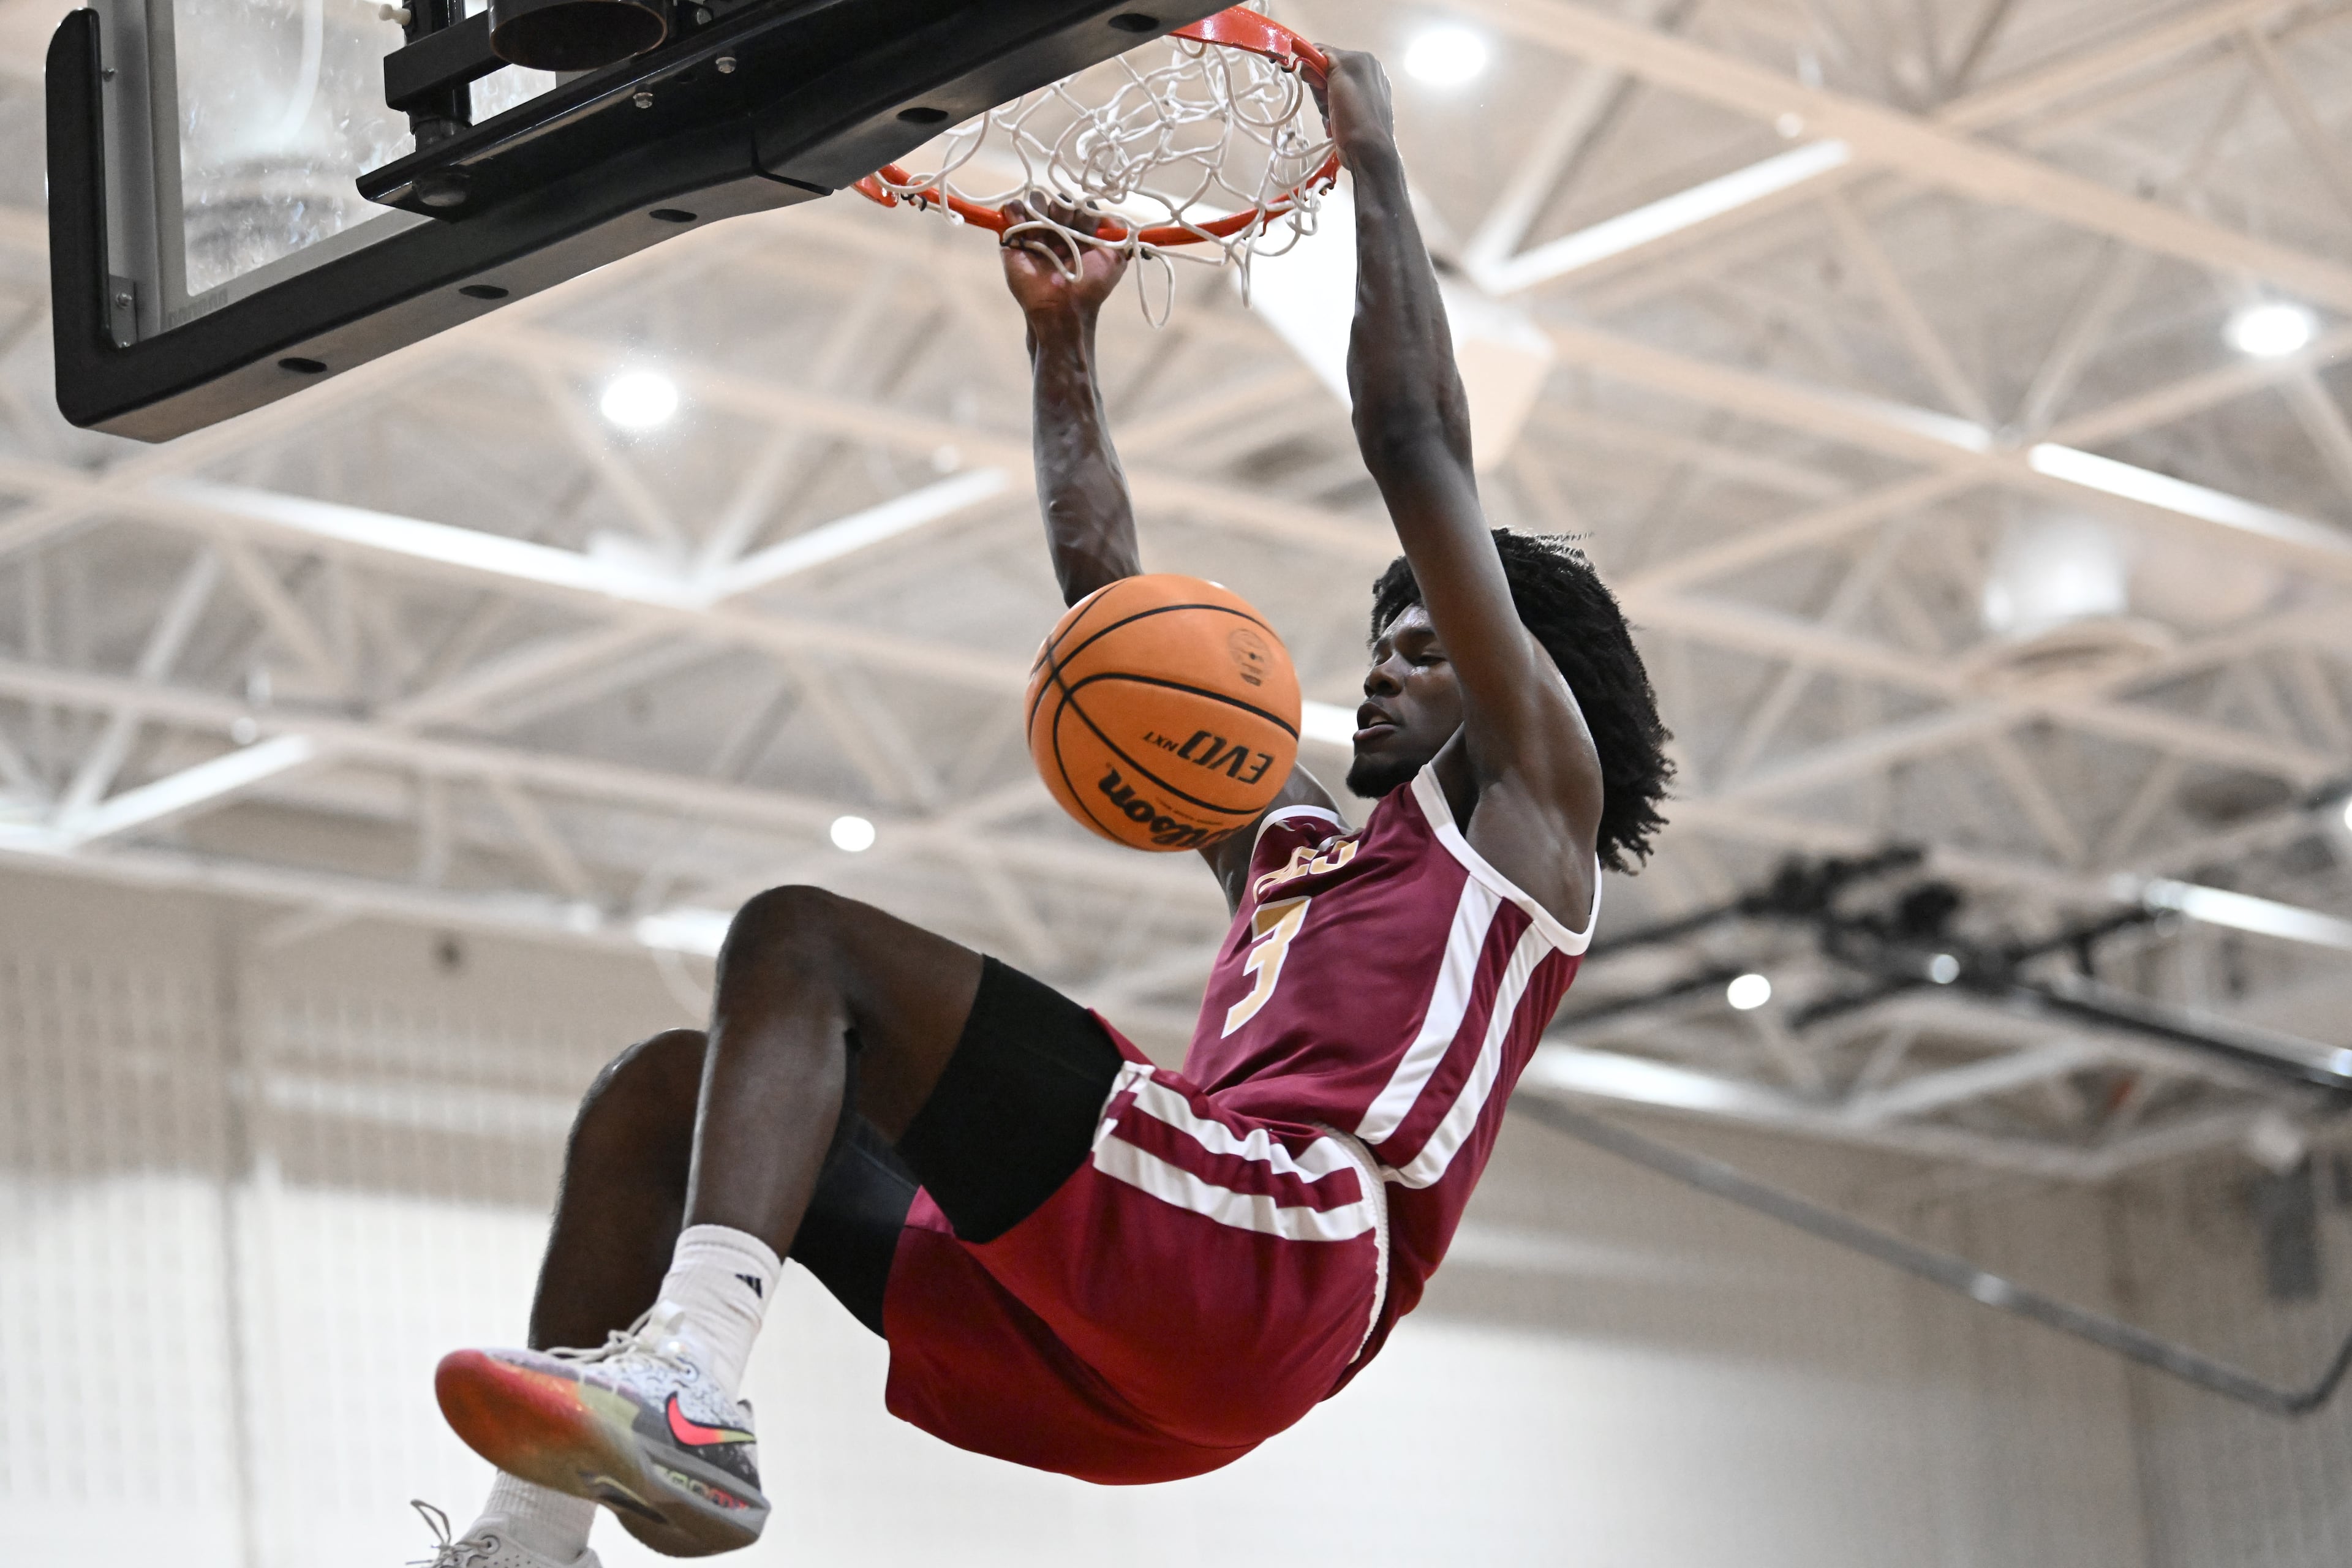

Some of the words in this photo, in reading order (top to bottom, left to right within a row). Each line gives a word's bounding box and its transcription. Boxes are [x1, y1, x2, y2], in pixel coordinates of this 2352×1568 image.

[1143, 731, 1180, 753] NXT
[1176, 729, 1274, 785] EVO
[1220, 895, 1312, 1039] 3
